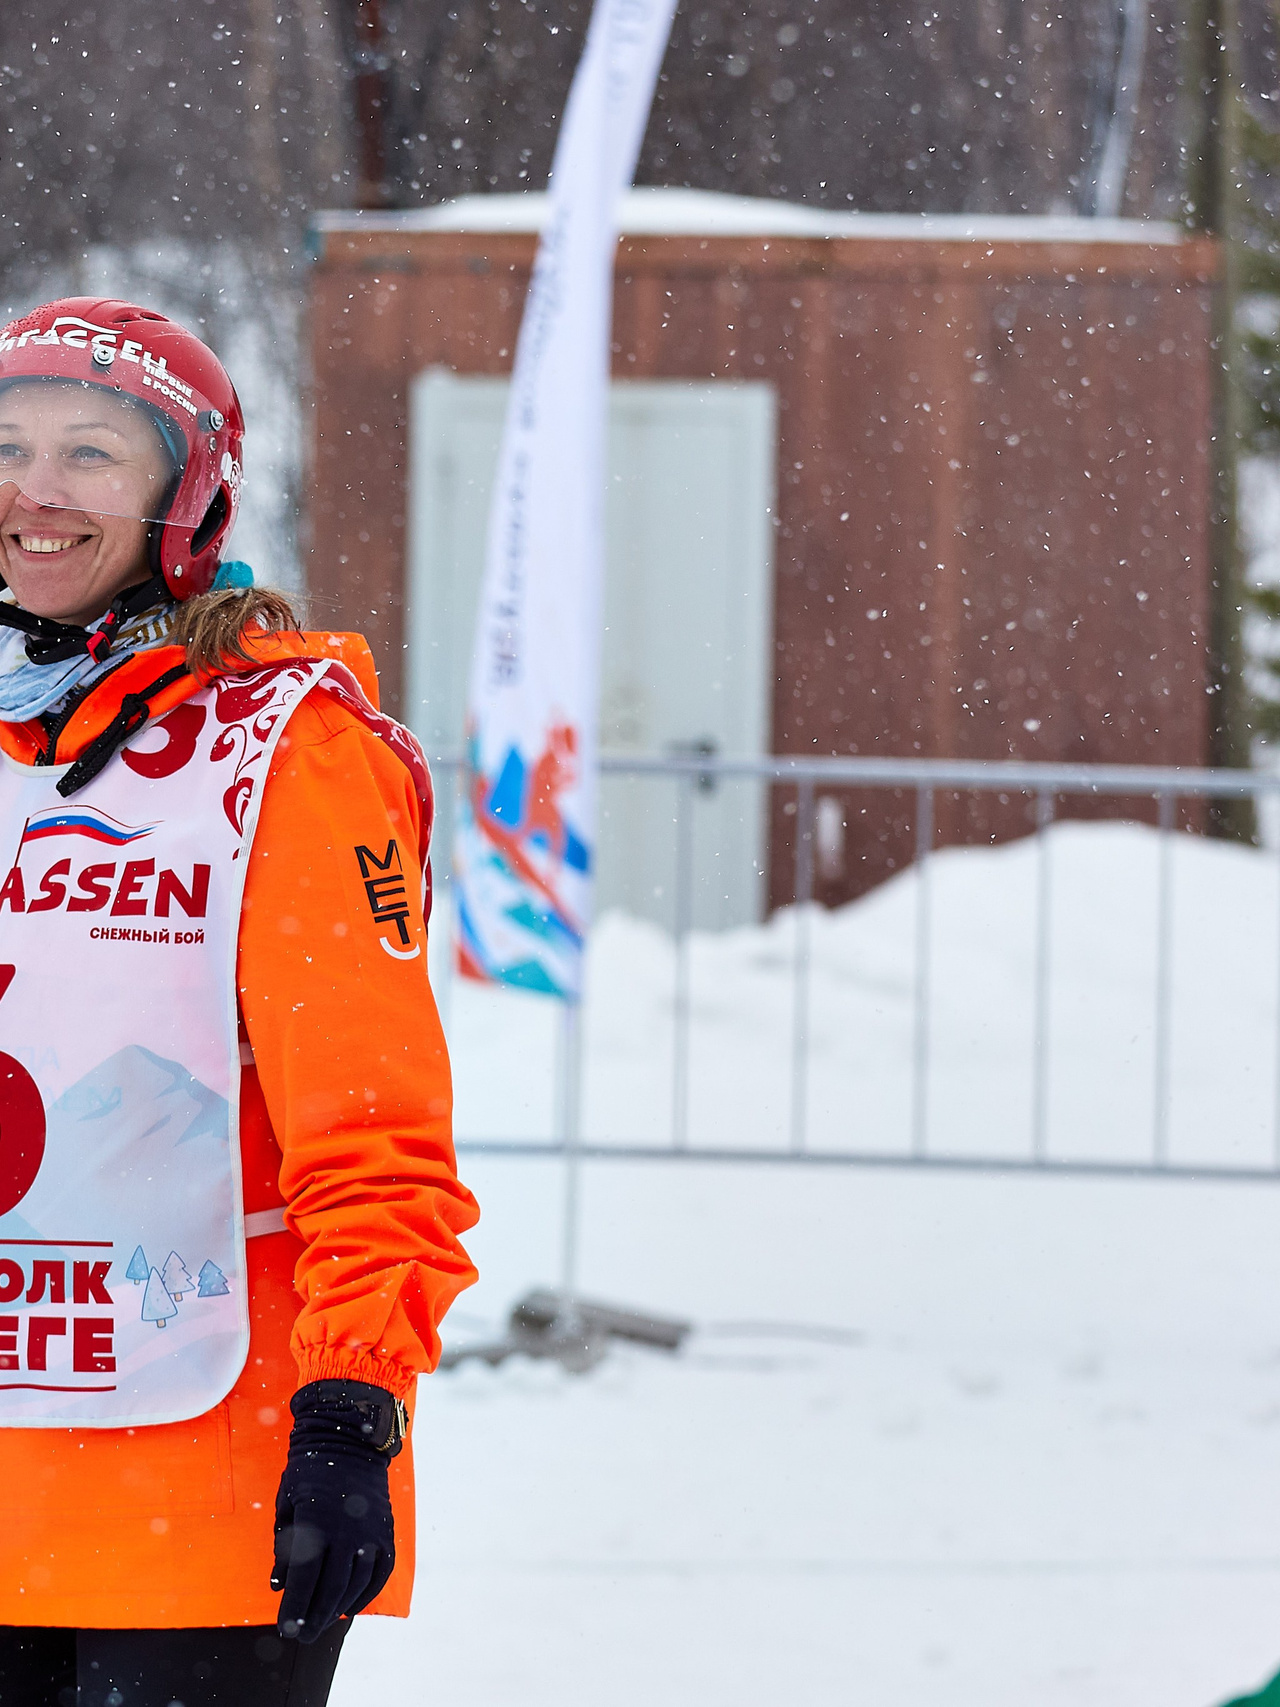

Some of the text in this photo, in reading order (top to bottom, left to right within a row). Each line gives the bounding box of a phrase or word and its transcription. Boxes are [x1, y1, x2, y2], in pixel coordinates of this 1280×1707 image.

[141, 375, 198, 417] В РОССИИ
[145, 362, 194, 399] ПЕРВЫЕ
[90, 927, 205, 944] СНЕЖНЫЙ БОЙ
